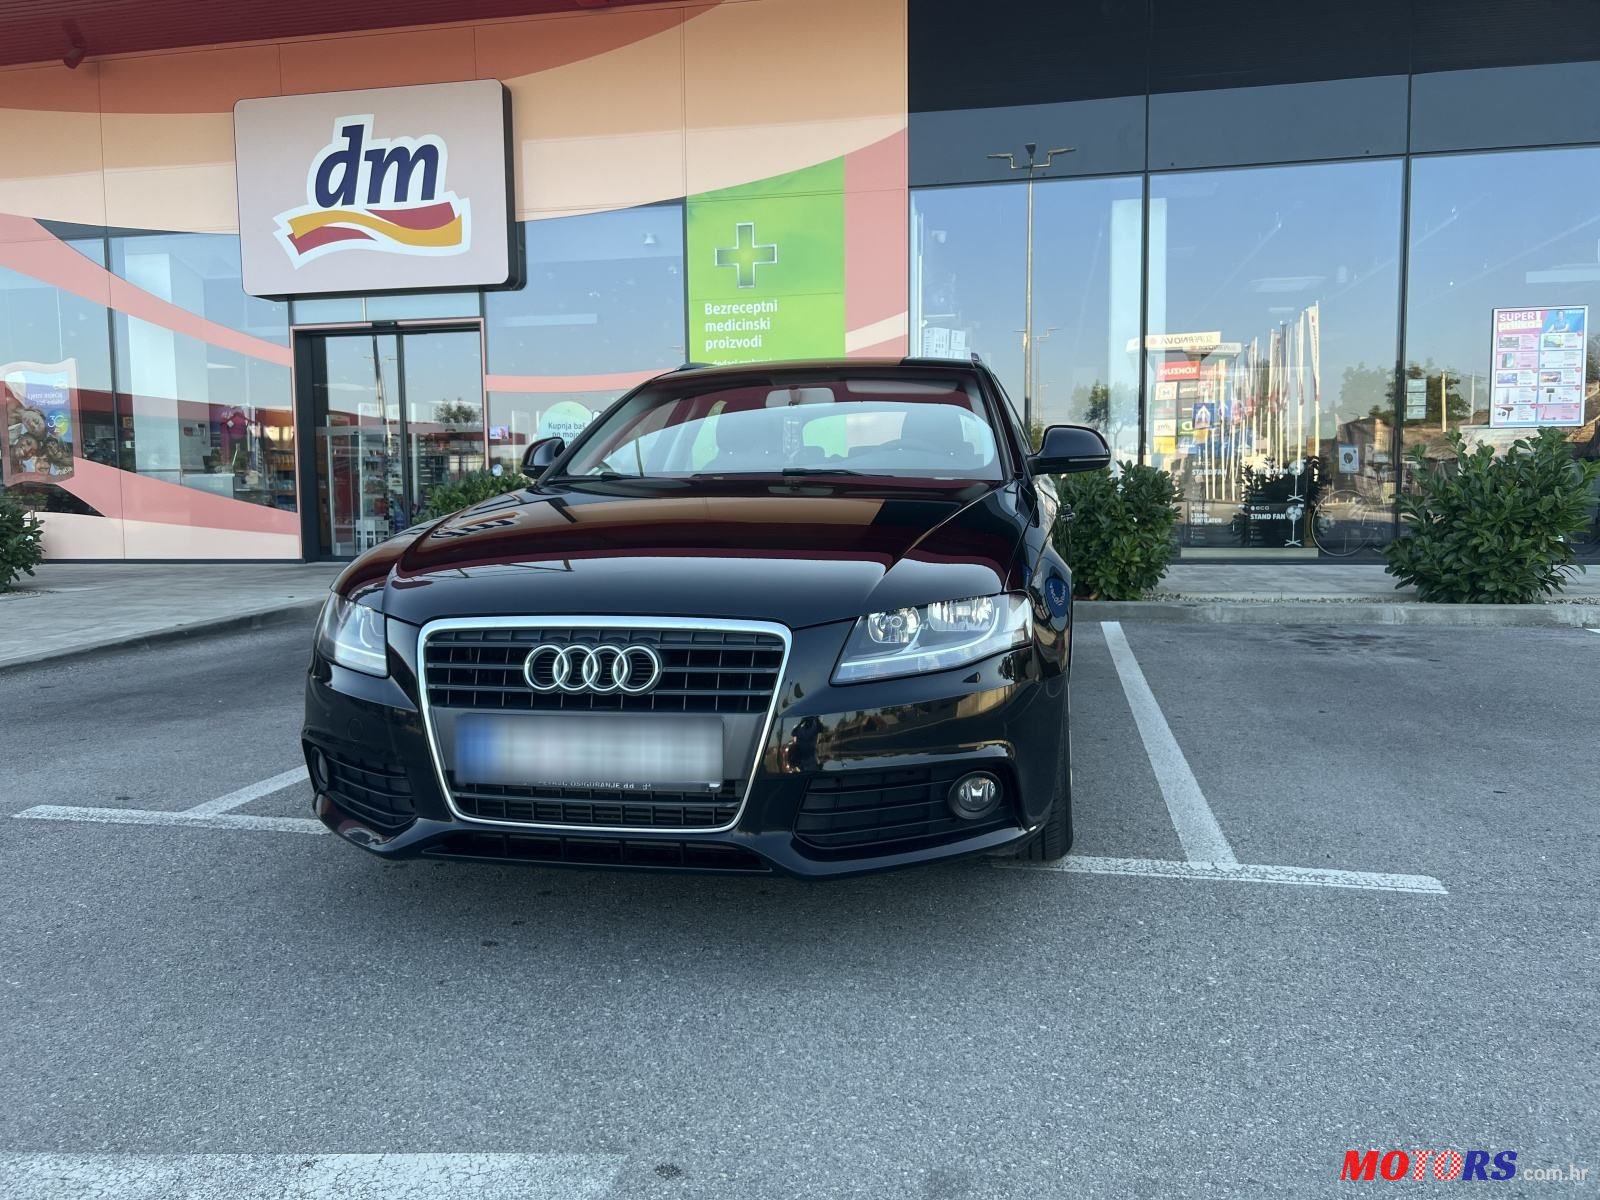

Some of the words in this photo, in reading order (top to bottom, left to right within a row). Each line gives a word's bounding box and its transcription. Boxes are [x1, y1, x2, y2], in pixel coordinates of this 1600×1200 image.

[314, 123, 441, 208] dm
[704, 300, 778, 315] Bezreceptni
[1498, 311, 1536, 322] SUPER
[704, 317, 771, 333] medicinski
[705, 335, 762, 353] proizvodi
[548, 422, 572, 431] Kupnja
